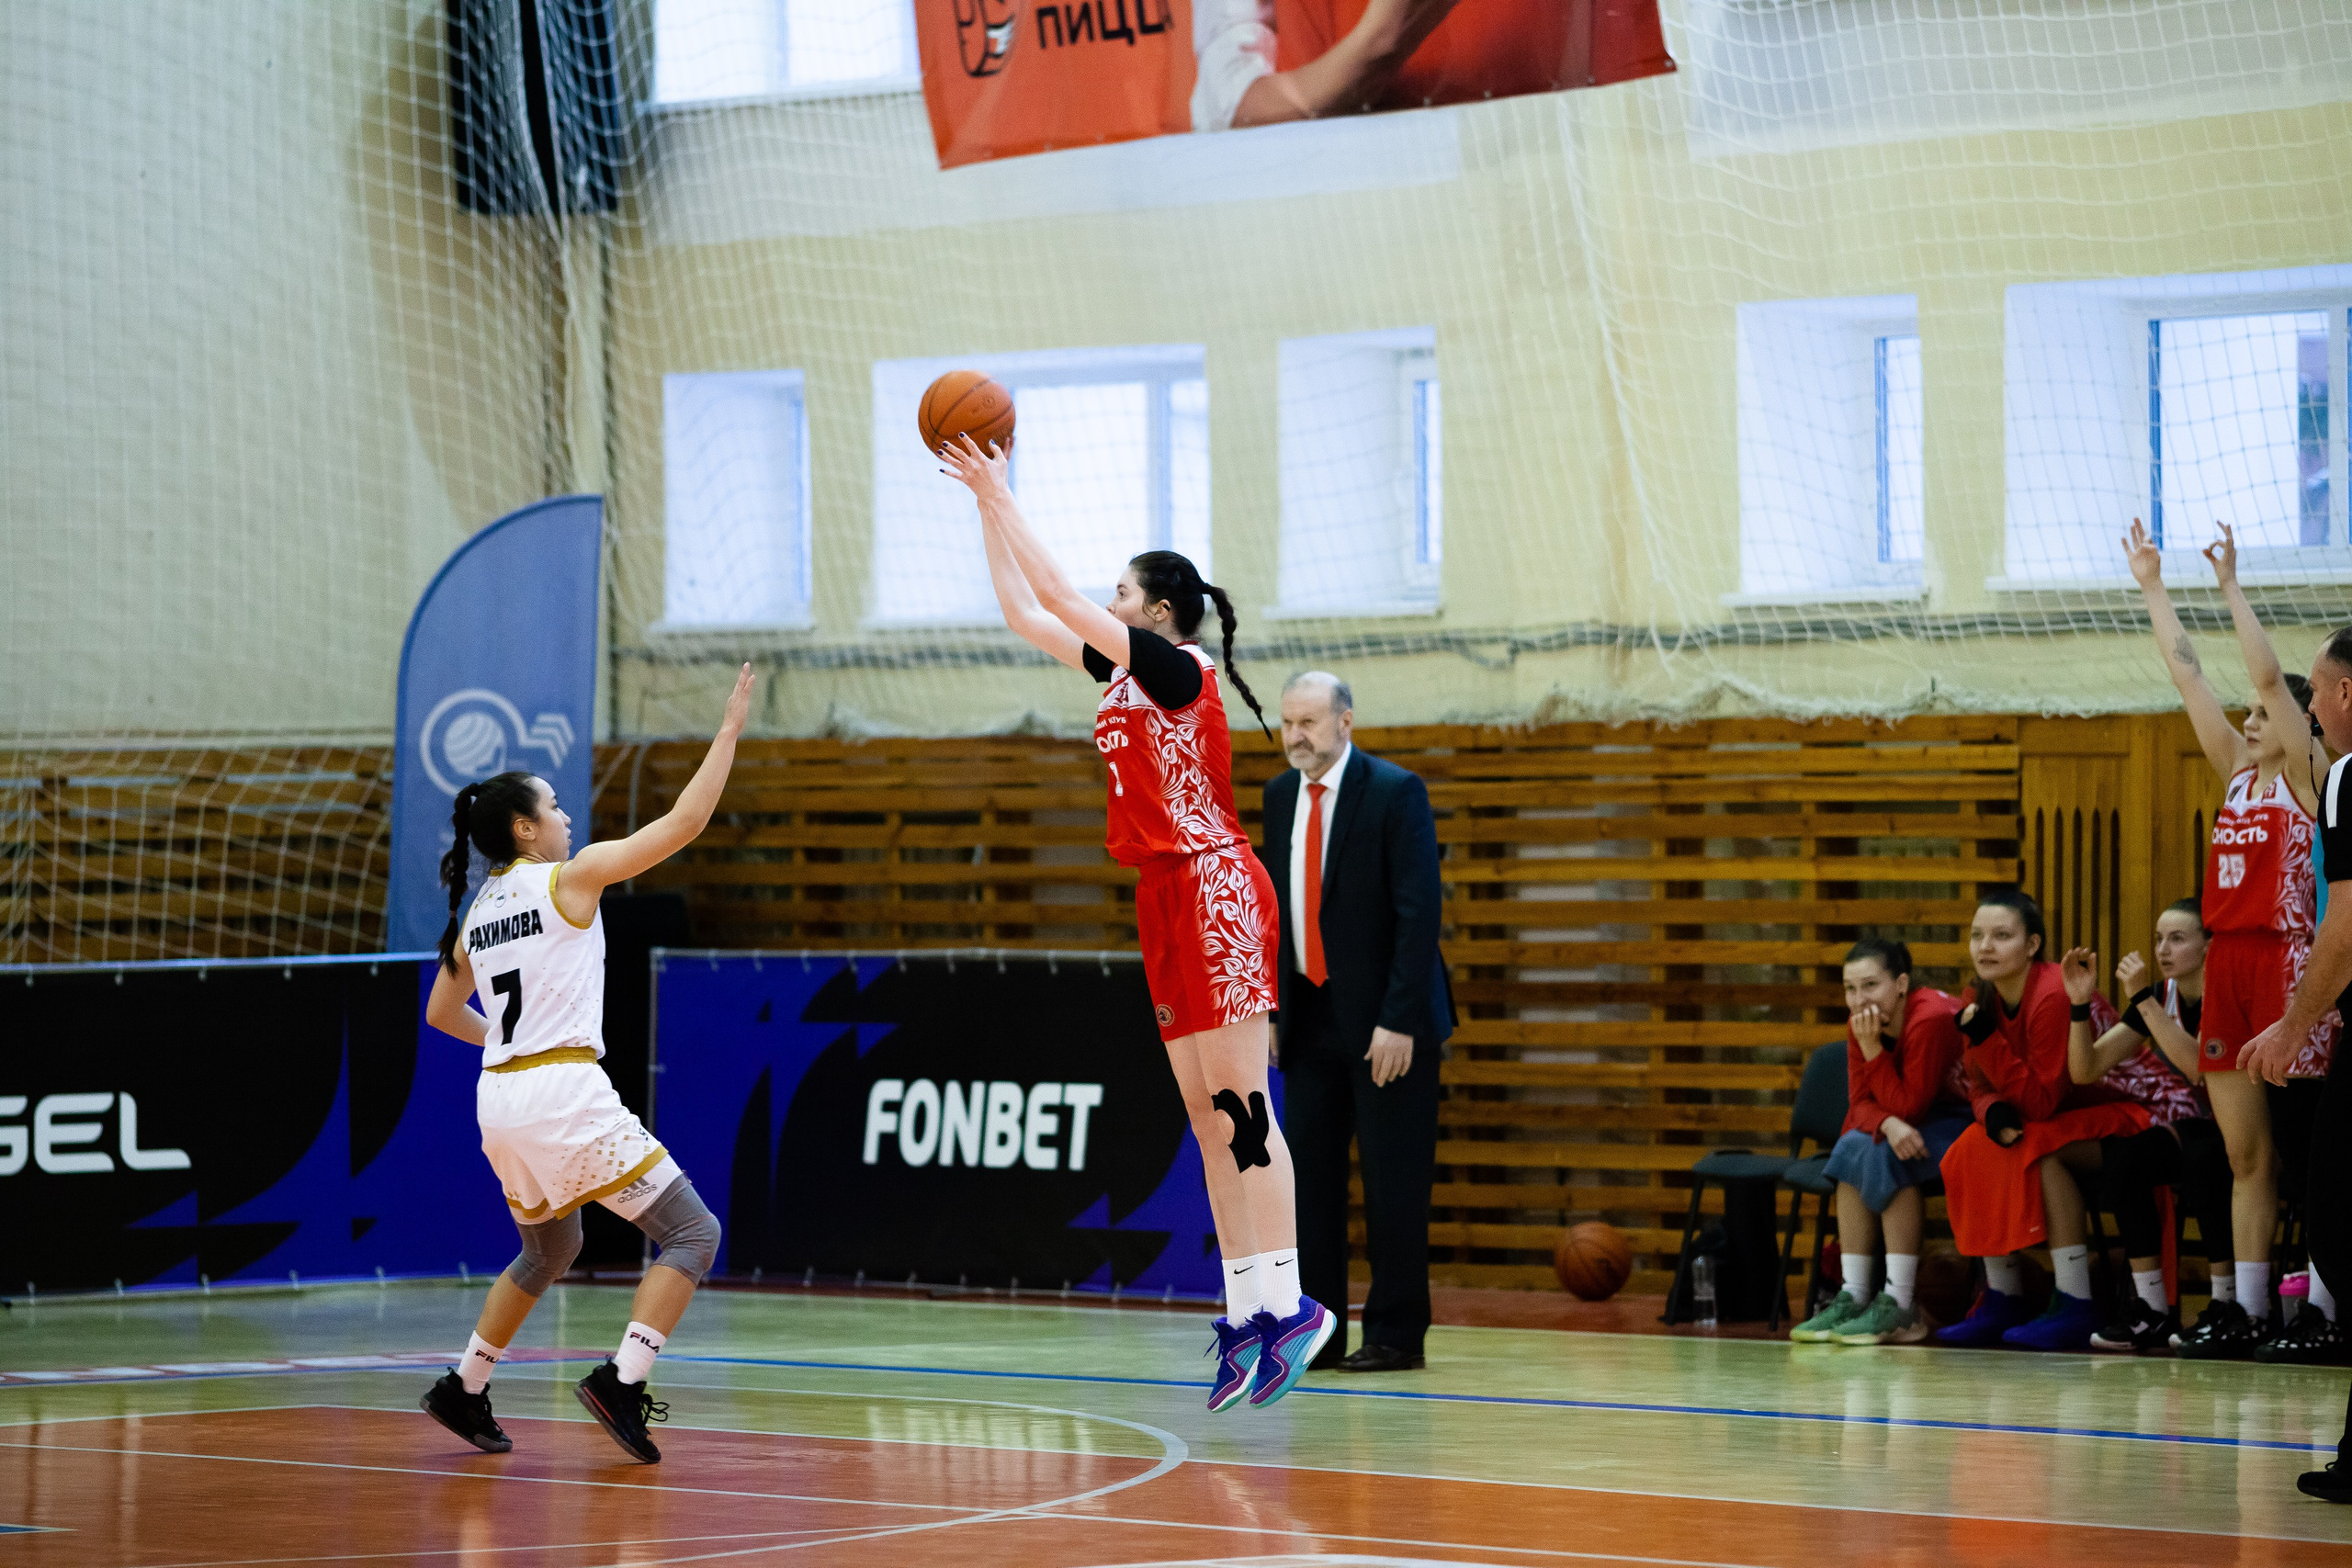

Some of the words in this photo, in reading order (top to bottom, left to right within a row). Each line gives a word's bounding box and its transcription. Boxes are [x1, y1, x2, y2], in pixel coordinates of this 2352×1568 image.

[2218, 852, 2246, 889] 25
[468, 908, 544, 955] РАХИМОВА
[491, 967, 522, 1046] 7
[863, 1077, 1103, 1172] FONBET
[617, 1183, 658, 1204] adidas
